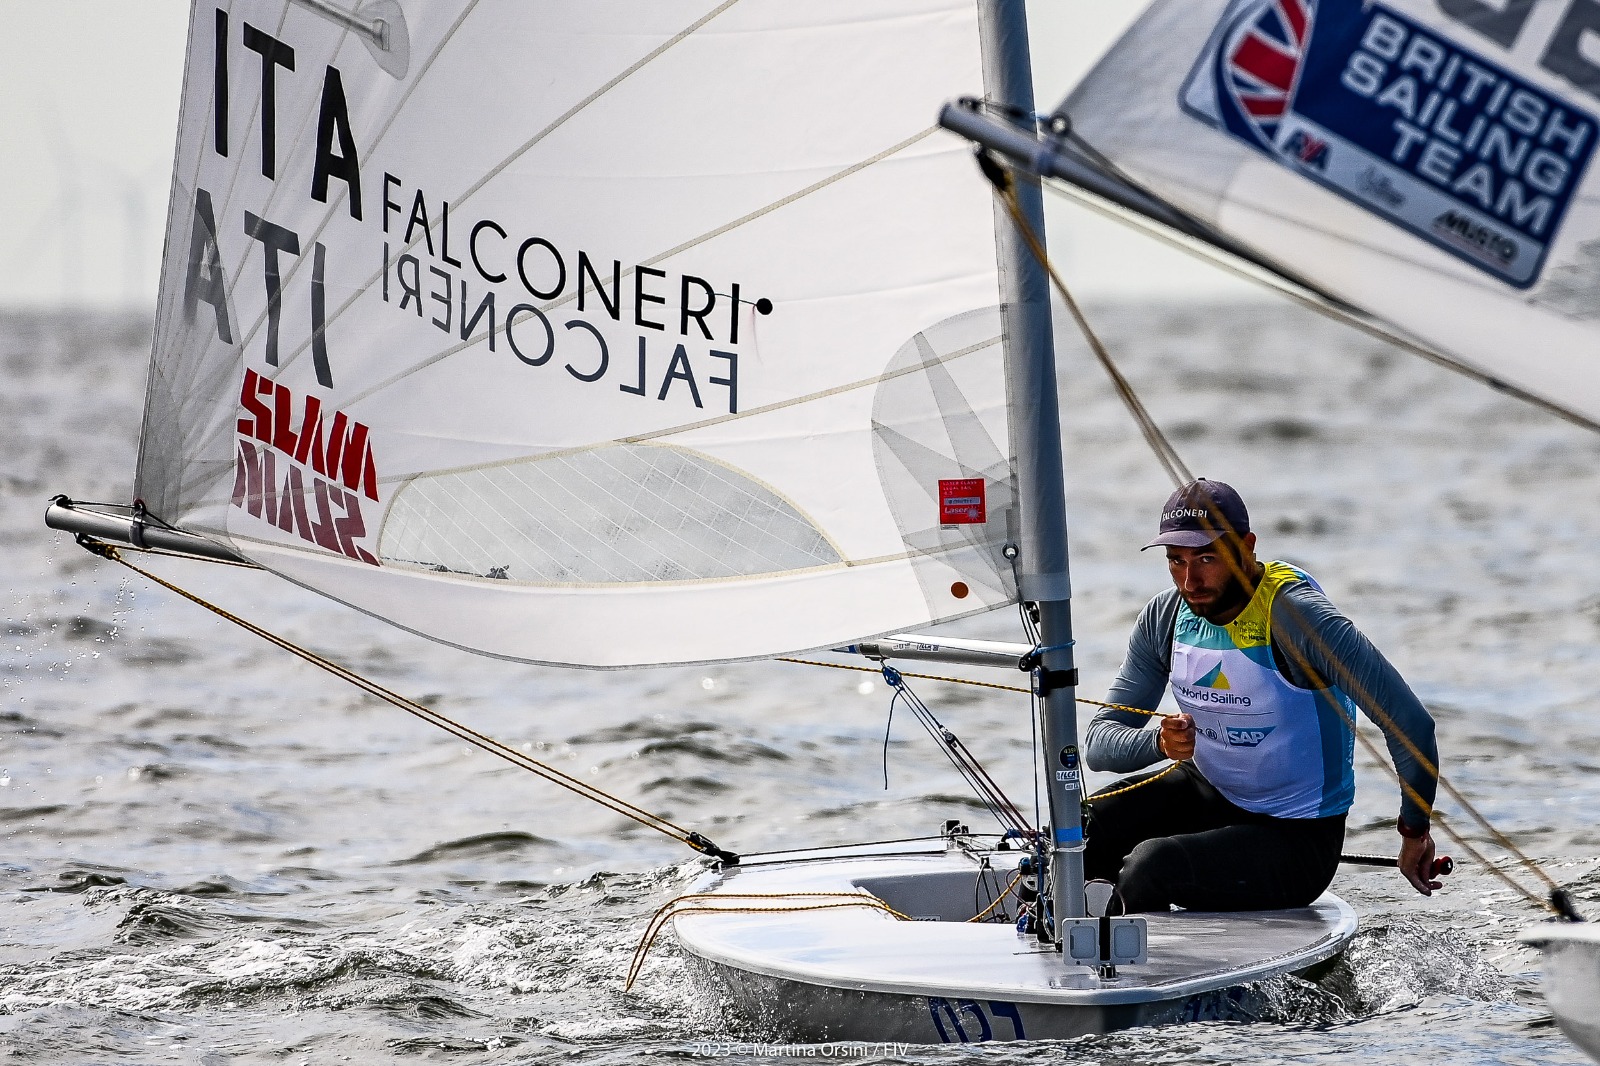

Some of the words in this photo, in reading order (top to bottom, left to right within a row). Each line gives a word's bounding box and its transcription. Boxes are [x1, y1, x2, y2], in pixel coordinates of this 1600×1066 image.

[214, 7, 363, 222] ITA
[1340, 50, 1571, 196] SAILING
[1362, 13, 1592, 160] BRITISH
[1391, 119, 1555, 236] TEAM
[383, 171, 740, 345] FALCONERI
[237, 367, 380, 503] SLAM
[944, 506, 968, 514] Laser
[1180, 619, 1201, 634] ITA
[1179, 685, 1209, 702] World
[1211, 693, 1251, 707] Sailing
[1228, 730, 1265, 744] SAP
